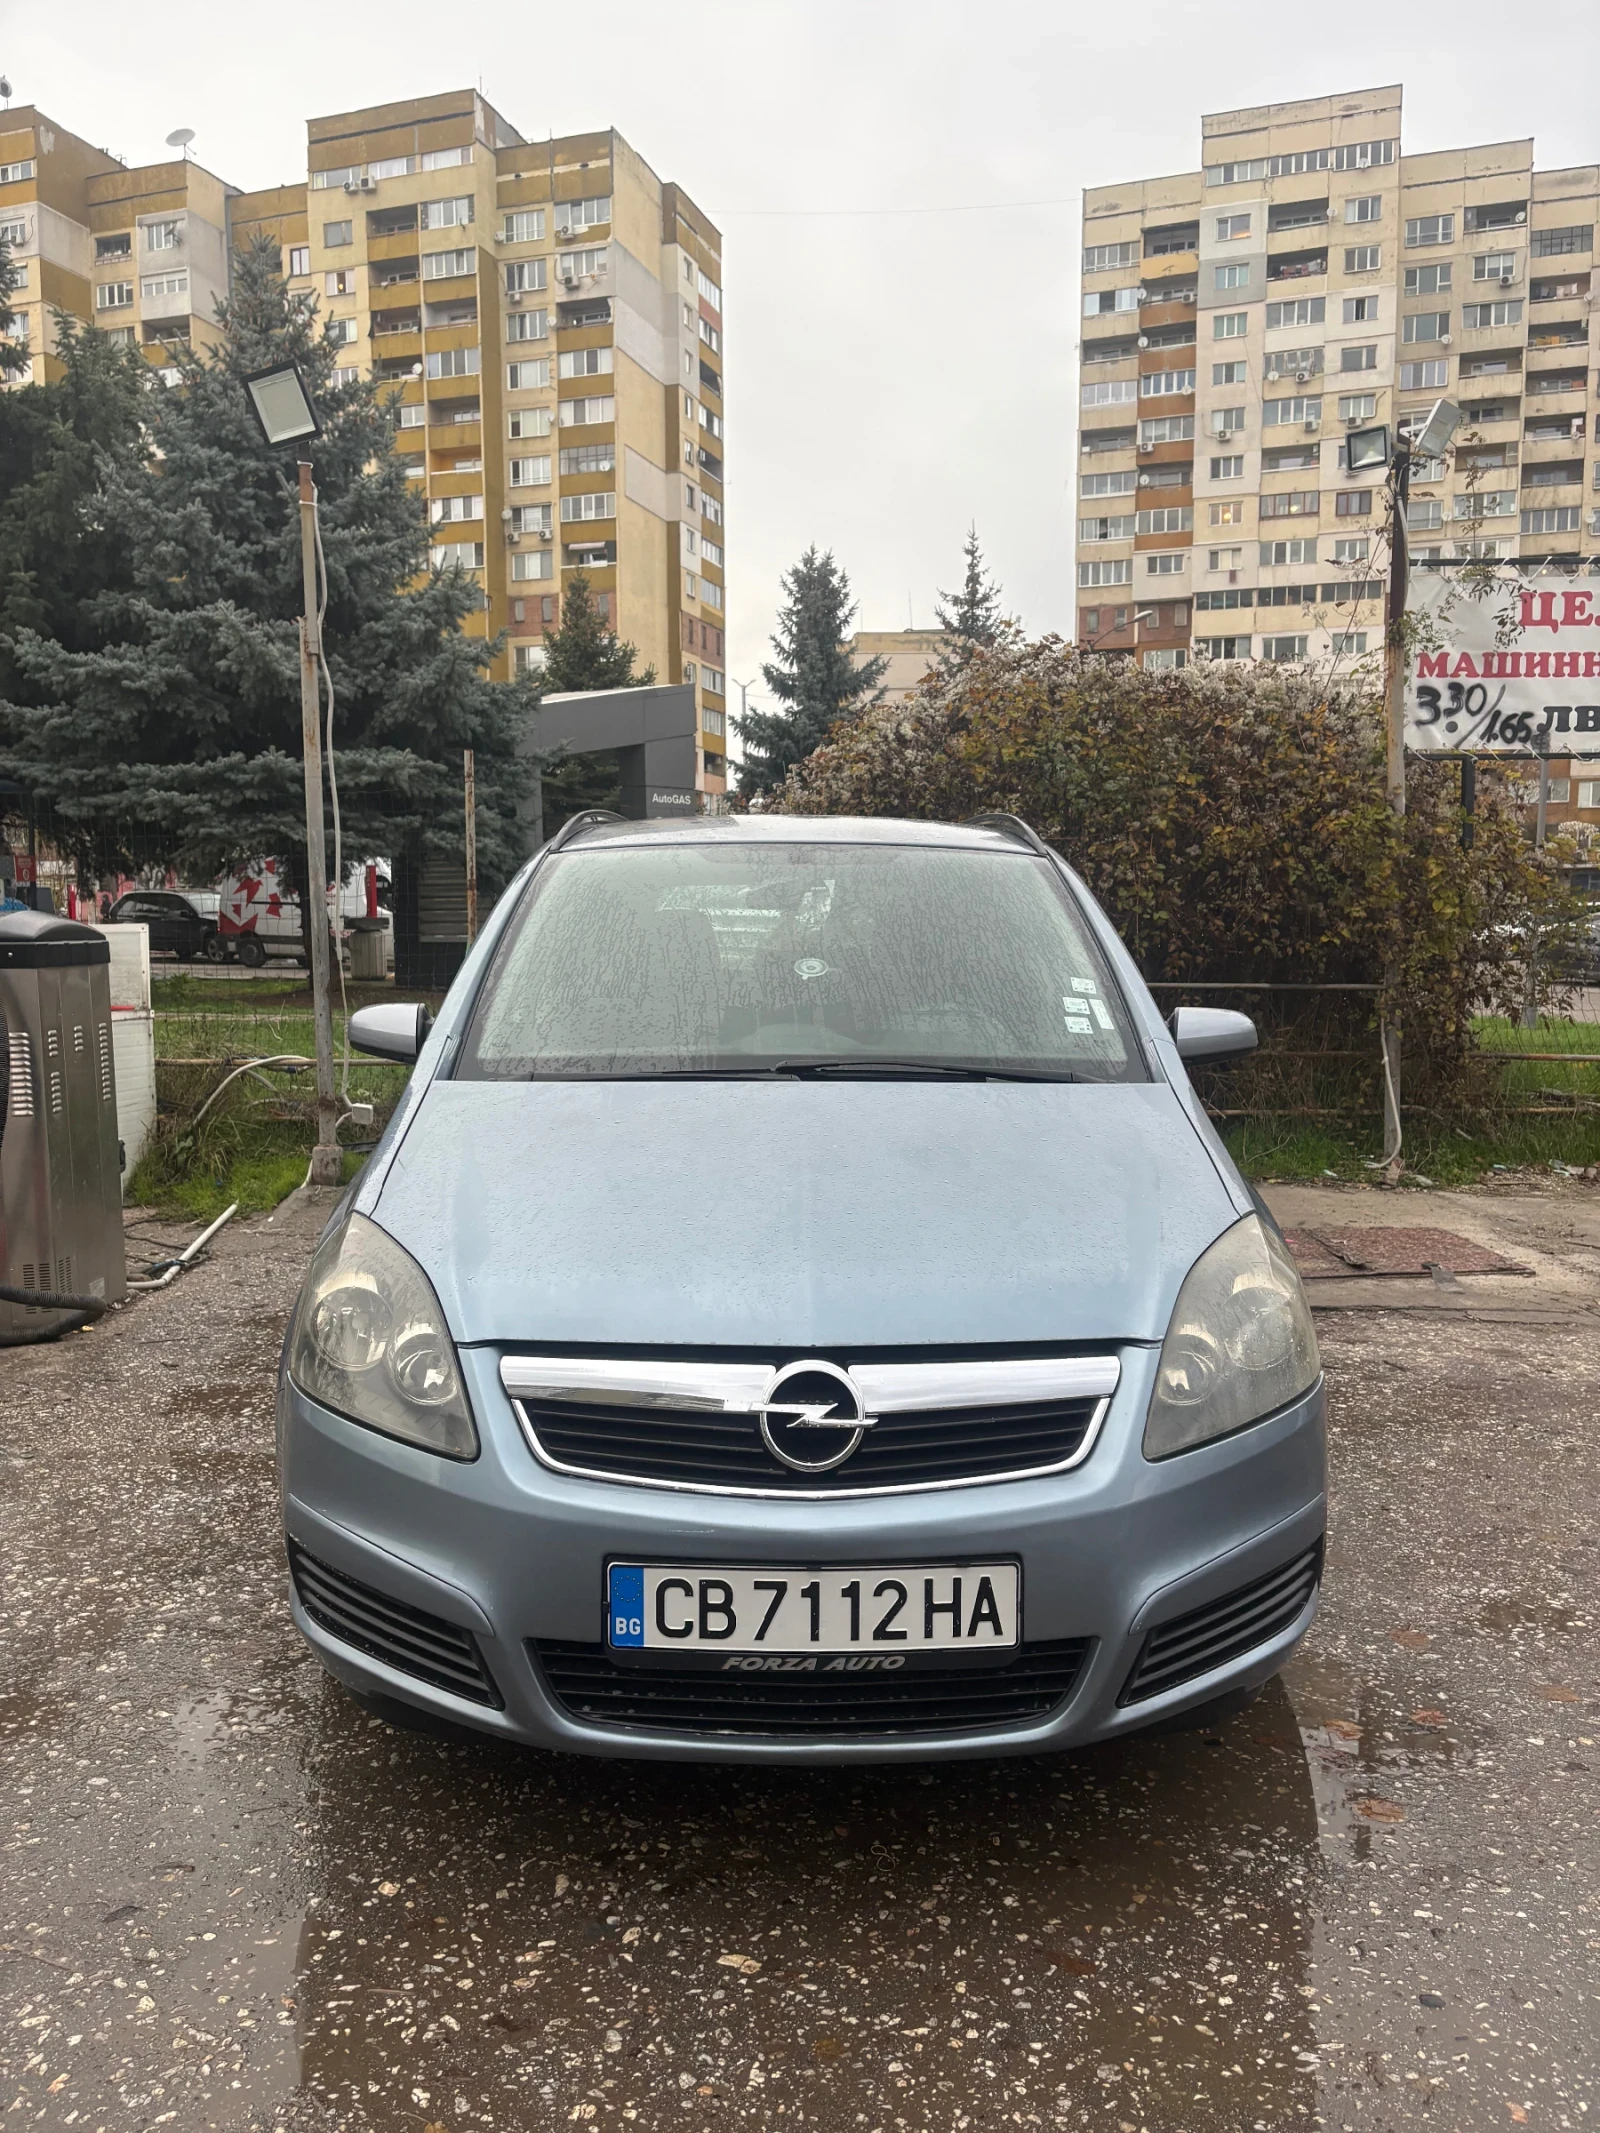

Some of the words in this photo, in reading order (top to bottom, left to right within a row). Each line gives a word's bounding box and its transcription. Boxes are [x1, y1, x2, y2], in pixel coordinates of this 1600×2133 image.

[1518, 590, 1600, 634] ЦЕ
[652, 793, 691, 805] AutoGAS
[615, 1616, 642, 1636] BG
[720, 1656, 818, 1672] FORZA
[822, 1655, 907, 1671] AUTO
